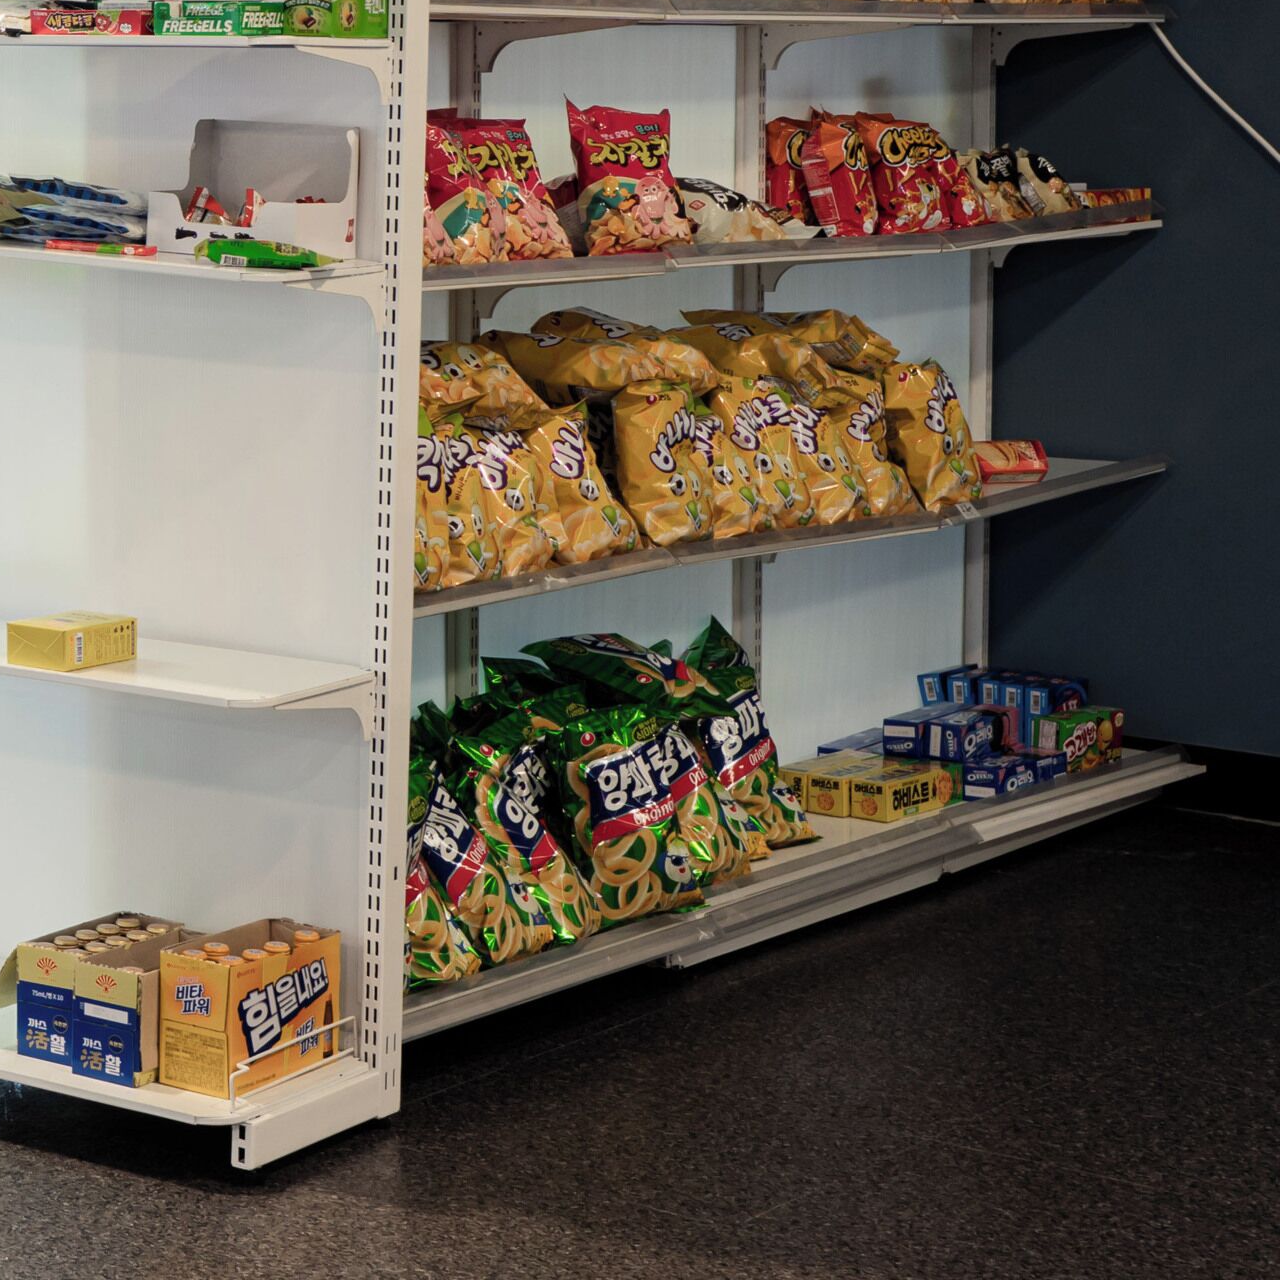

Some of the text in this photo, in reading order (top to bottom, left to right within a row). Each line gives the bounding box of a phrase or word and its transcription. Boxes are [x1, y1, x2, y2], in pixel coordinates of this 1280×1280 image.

[162, 19, 232, 33] FREEGELLS
[586, 134, 670, 168] 자갈치
[892, 779, 930, 812] 하비스트
[175, 984, 205, 1001] 비타
[182, 998, 211, 1017] 파워
[27, 1017, 48, 1030] 까스
[82, 1037, 103, 1050] 까스
